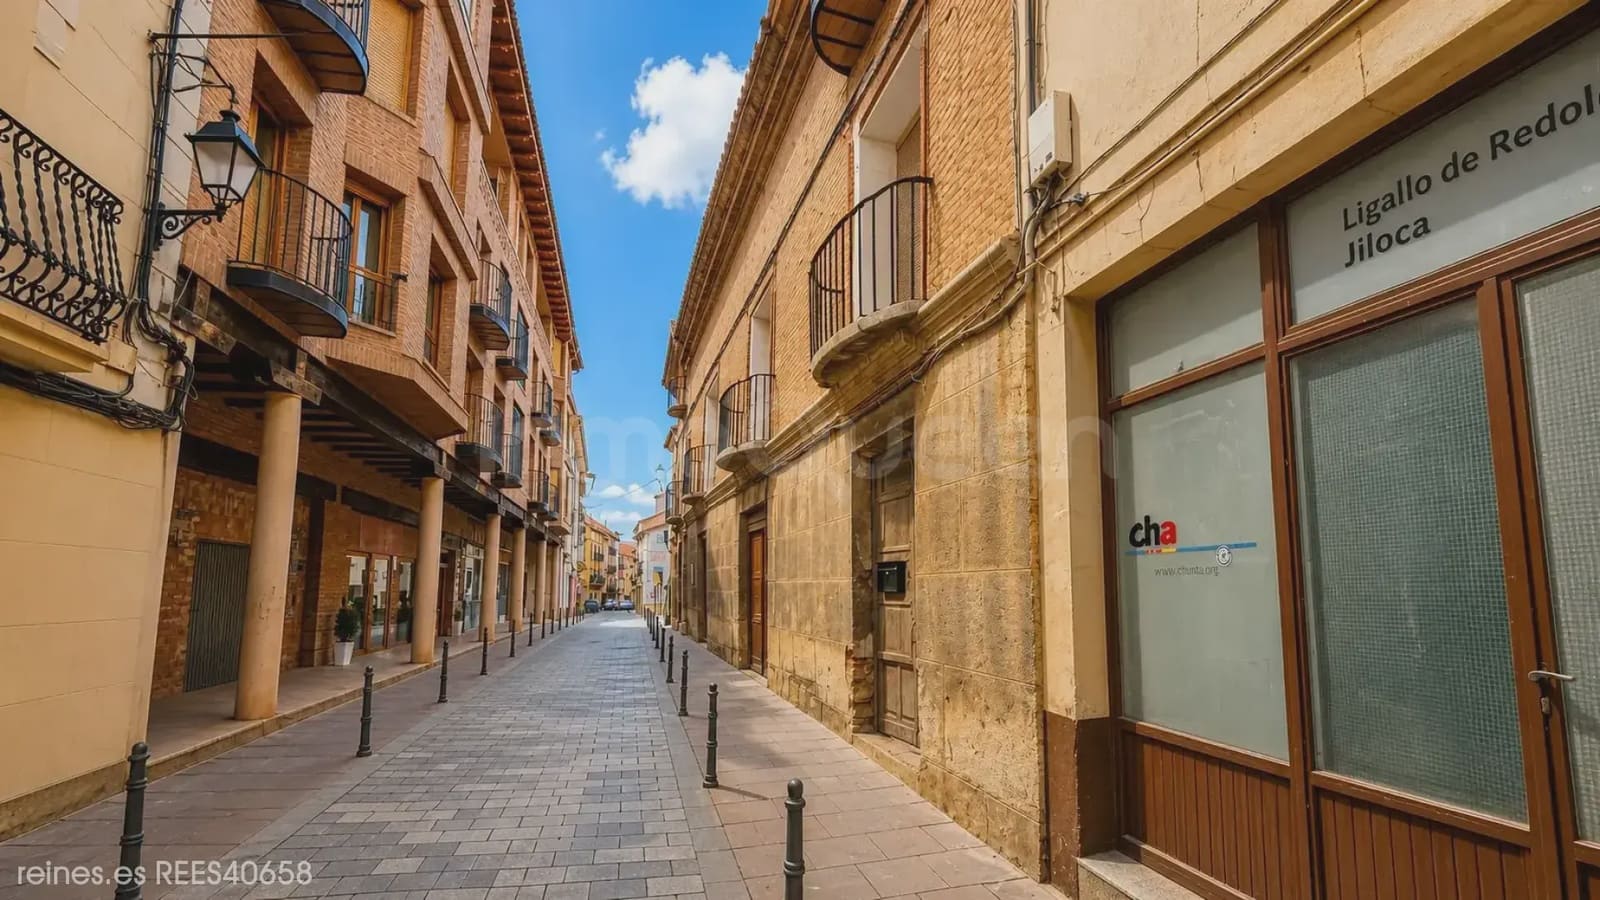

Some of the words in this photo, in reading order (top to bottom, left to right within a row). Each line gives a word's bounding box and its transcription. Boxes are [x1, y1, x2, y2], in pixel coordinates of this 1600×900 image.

[1342, 175, 1432, 231] Ligallo
[1441, 151, 1479, 183] de
[1489, 83, 1600, 161] Redol
[1344, 215, 1431, 268] Jiloca
[1129, 515, 1177, 548] cha
